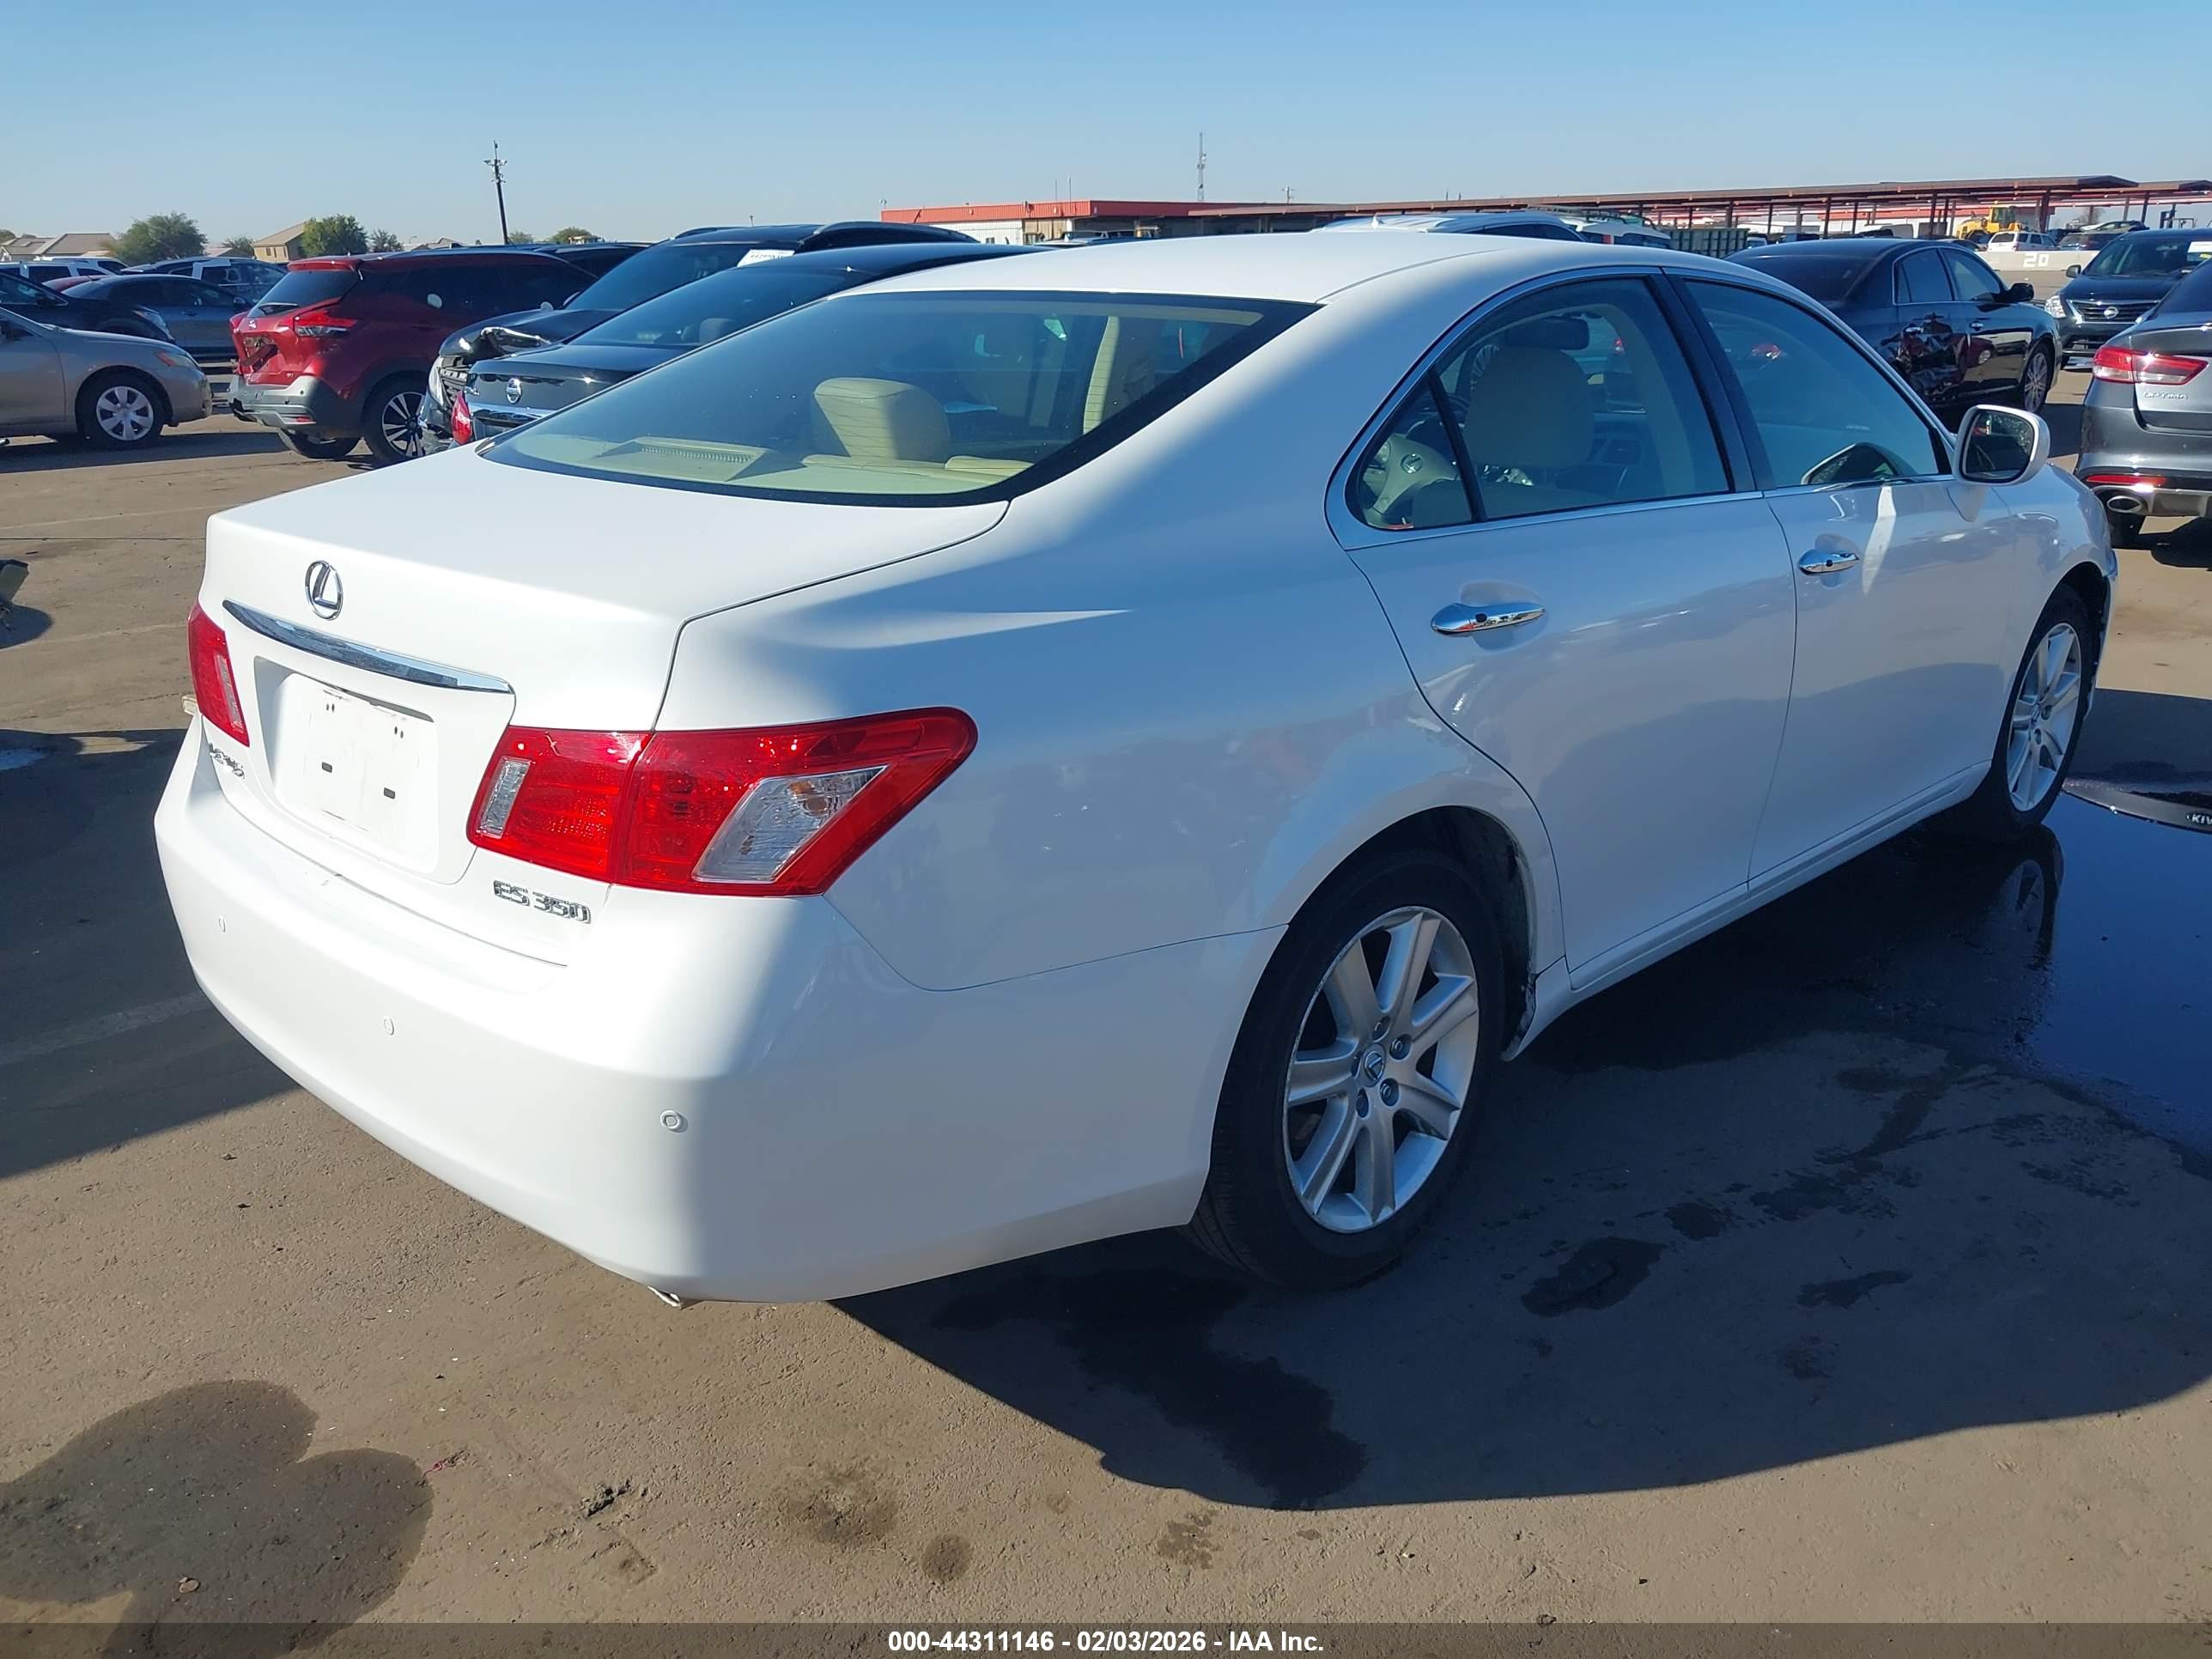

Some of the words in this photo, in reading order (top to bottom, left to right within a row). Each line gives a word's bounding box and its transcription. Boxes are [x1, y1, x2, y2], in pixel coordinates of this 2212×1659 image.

[2023, 252, 2050, 268] 20
[493, 879, 531, 907] ES
[532, 891, 592, 925] 350
